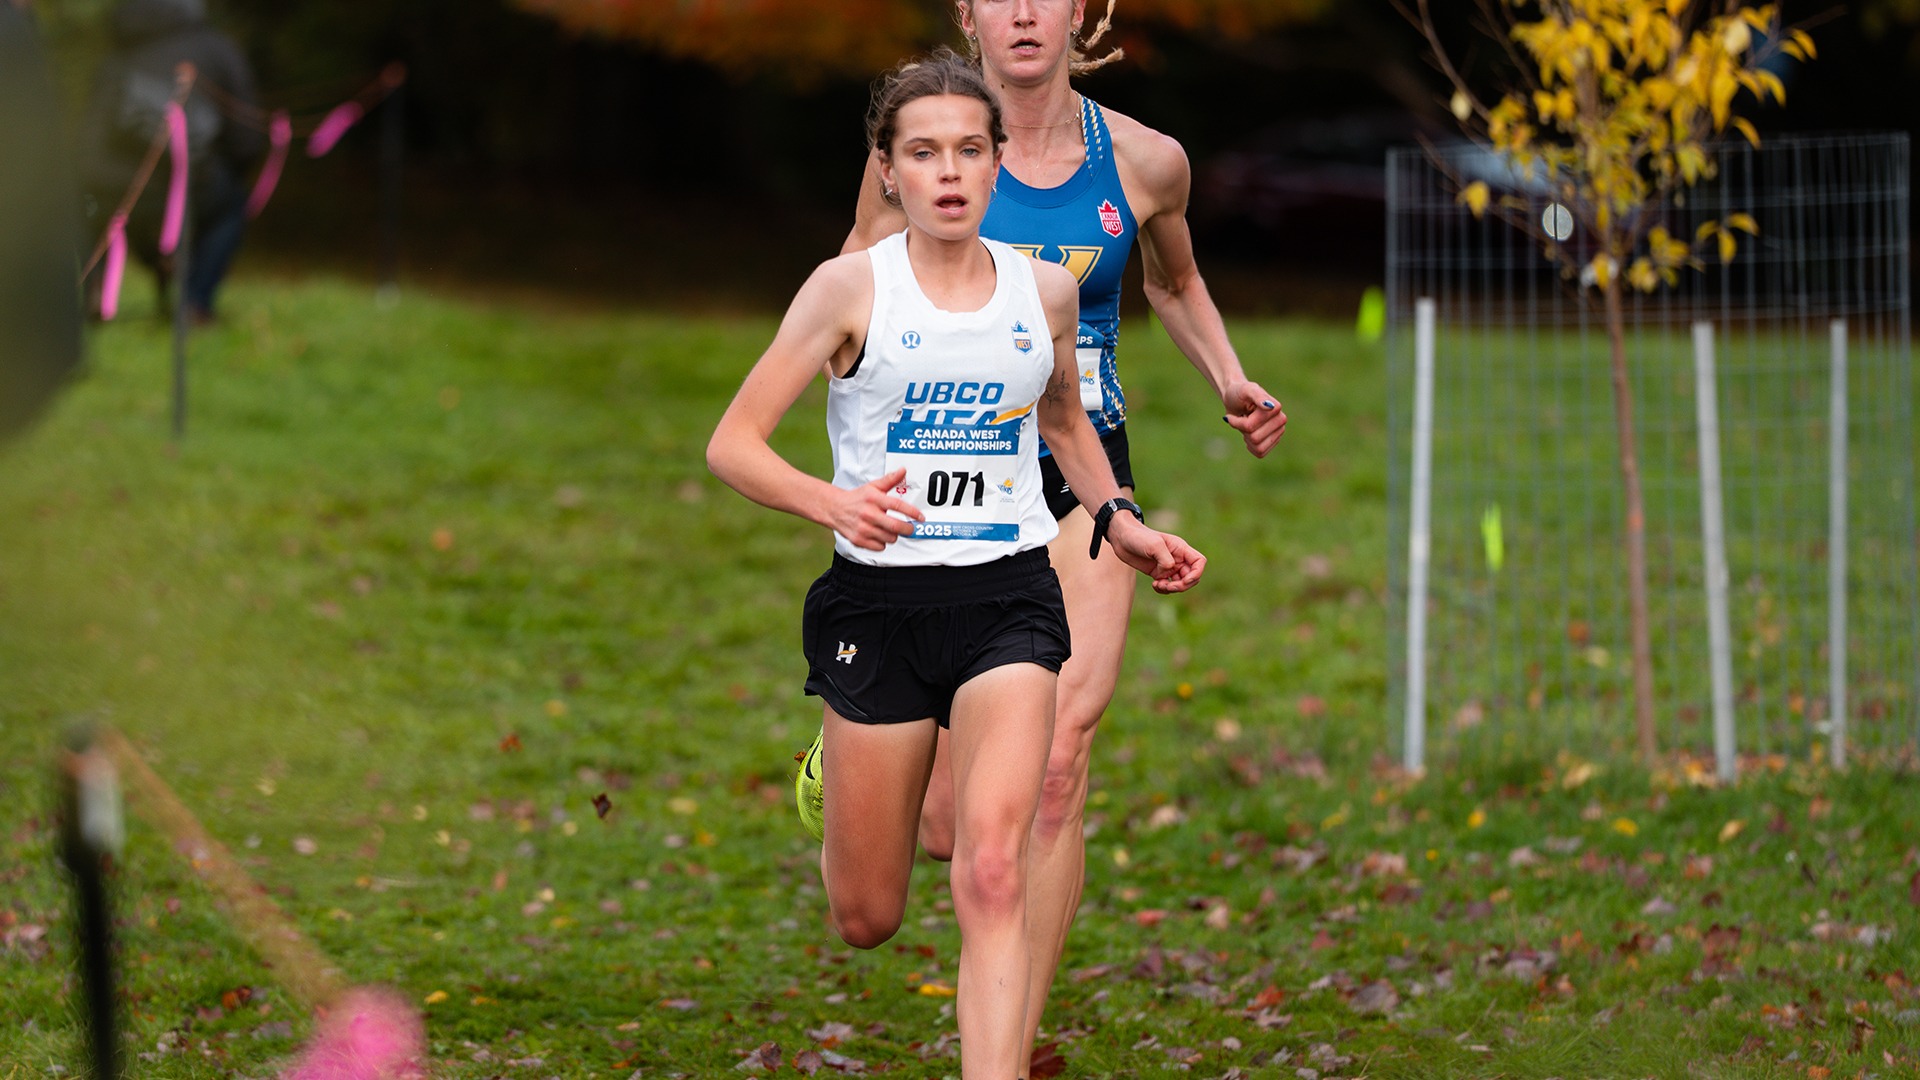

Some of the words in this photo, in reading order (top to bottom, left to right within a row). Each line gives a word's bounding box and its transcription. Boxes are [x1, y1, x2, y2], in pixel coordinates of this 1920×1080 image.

[1103, 221, 1120, 231] WEST
[904, 382, 1005, 405] UBCO
[914, 429, 967, 439] CANADA
[970, 430, 1001, 439] WEST
[899, 439, 915, 449] XC
[918, 440, 1012, 451] CHAMPIONSHIPS
[927, 470, 985, 507] 071
[915, 524, 952, 536] 2025
